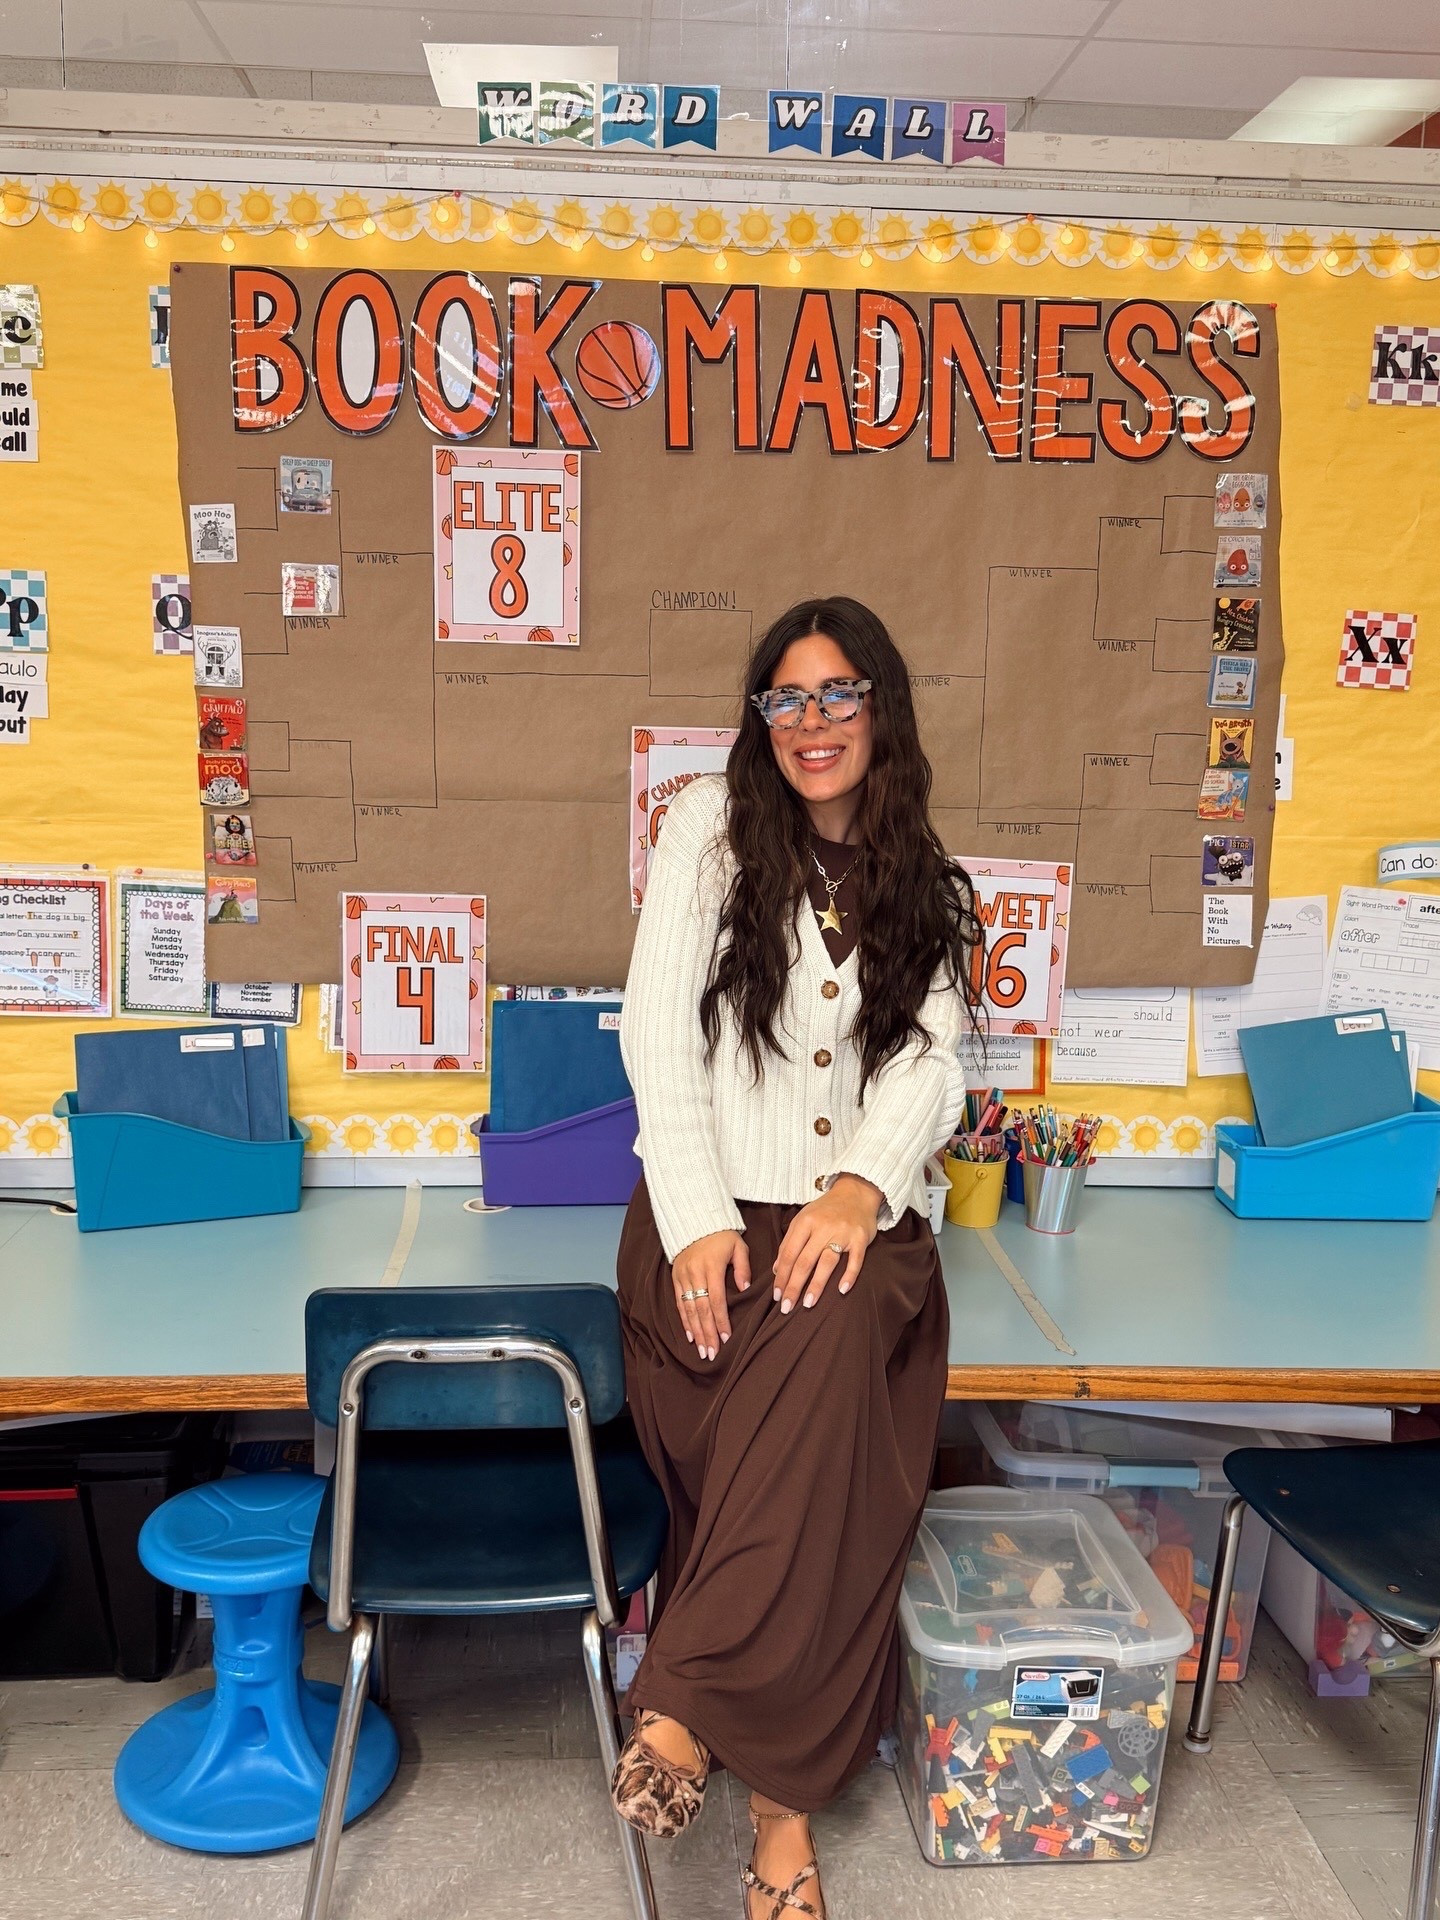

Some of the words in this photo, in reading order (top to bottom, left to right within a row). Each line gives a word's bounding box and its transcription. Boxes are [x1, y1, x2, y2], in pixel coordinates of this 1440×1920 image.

[483, 89, 707, 127] WORD
[774, 97, 994, 144] WALL
[229, 266, 601, 451] BOOK
[661, 284, 1261, 464] MADNESS
[1373, 341, 1439, 381] Kk
[453, 480, 562, 532] ELITE
[194, 511, 212, 520] Moo
[214, 510, 231, 519] Hoo
[1107, 518, 1142, 530] WINNER
[356, 553, 400, 566] WINNER
[489, 534, 529, 618] 8
[1009, 566, 1053, 579] WINNER
[651, 590, 736, 609] CHAMPION!
[0, 587, 40, 638] p
[288, 617, 330, 630] WINNER
[1098, 640, 1138, 654] WINNER
[1344, 625, 1408, 665] Xx
[444, 674, 490, 686] WINNER
[909, 676, 950, 688] WINNER
[203, 704, 243, 714] GRUFFALO
[1090, 757, 1130, 768] WINNER
[204, 764, 242, 775] moo
[360, 807, 402, 817] WINNER
[996, 824, 1042, 836] WINNER
[1208, 838, 1224, 847] PIG
[1232, 841, 1249, 850] STAR
[295, 863, 337, 874] WINNER
[1380, 858, 1405, 873] Can
[1412, 854, 1438, 869] do:
[1086, 884, 1128, 896] WINNER
[13, 894, 66, 905] Checklist
[145, 898, 173, 910] Days
[176, 900, 190, 909] of
[140, 910, 159, 920] the
[163, 911, 194, 921] Week
[973, 890, 1054, 930] WEET
[46, 913, 60, 922] dog
[153, 927, 181, 936] Sunday
[1341, 928, 1380, 943] after
[151, 935, 182, 944] Monday
[366, 925, 464, 964] FINAL
[1207, 937, 1240, 945] Pictures
[151, 943, 182, 951] Tuesday
[144, 951, 189, 960] Wednesday
[149, 959, 184, 968] Thursday
[968, 929, 1027, 1009] 16
[154, 967, 178, 975] Friday
[149, 974, 183, 983] Saturday
[396, 966, 436, 1045] 4
[1134, 1006, 1172, 1022] should
[1060, 1022, 1081, 1037] not
[1094, 1028, 1124, 1038] wear
[1057, 1041, 1098, 1057] because
